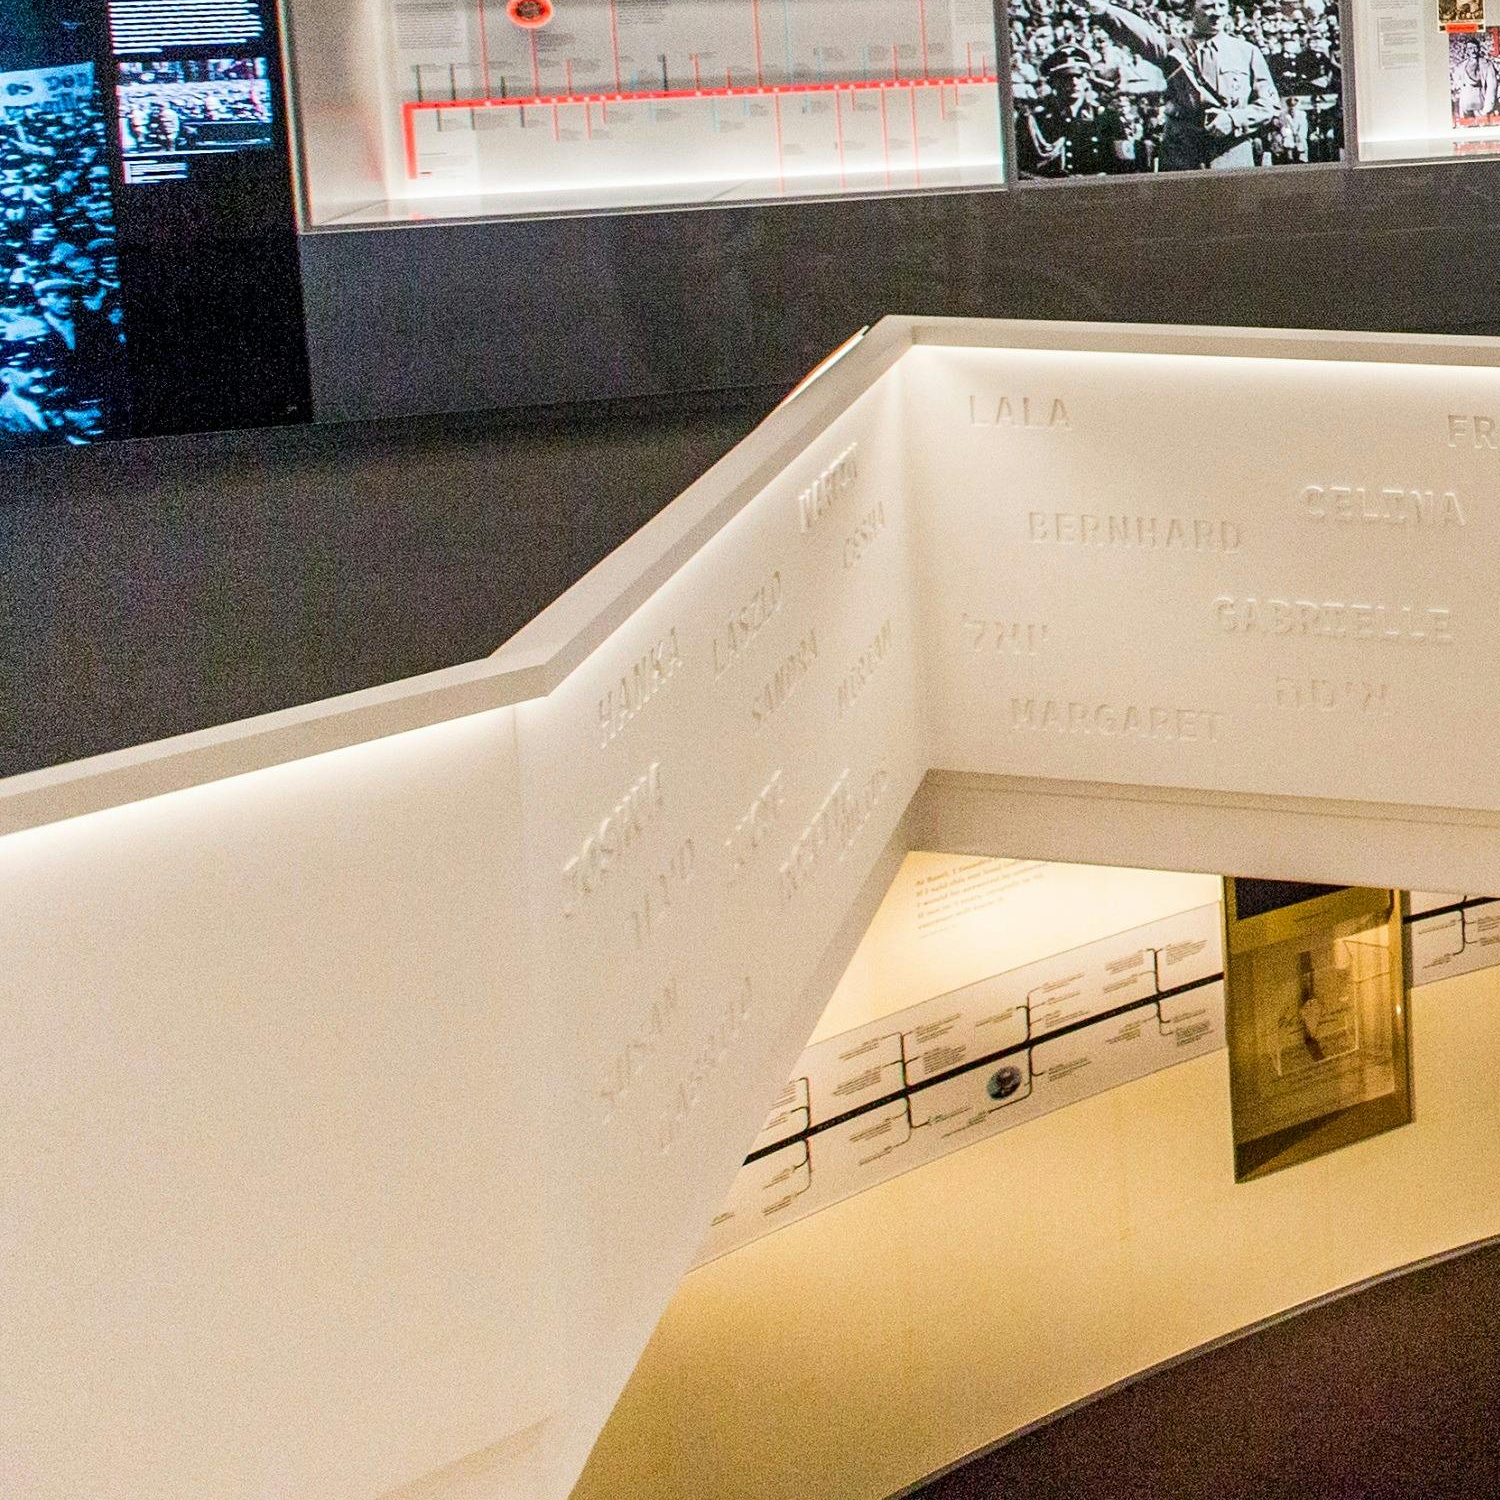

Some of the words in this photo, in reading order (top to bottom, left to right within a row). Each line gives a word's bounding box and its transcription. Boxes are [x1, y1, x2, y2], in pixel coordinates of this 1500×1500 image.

[967, 393, 1073, 432] LALA
[1298, 484, 1469, 529] CELINA
[1026, 509, 1245, 557] BERNHARD
[1210, 592, 1457, 646] GABRIELLE
[1008, 695, 1226, 745] MARGARET
